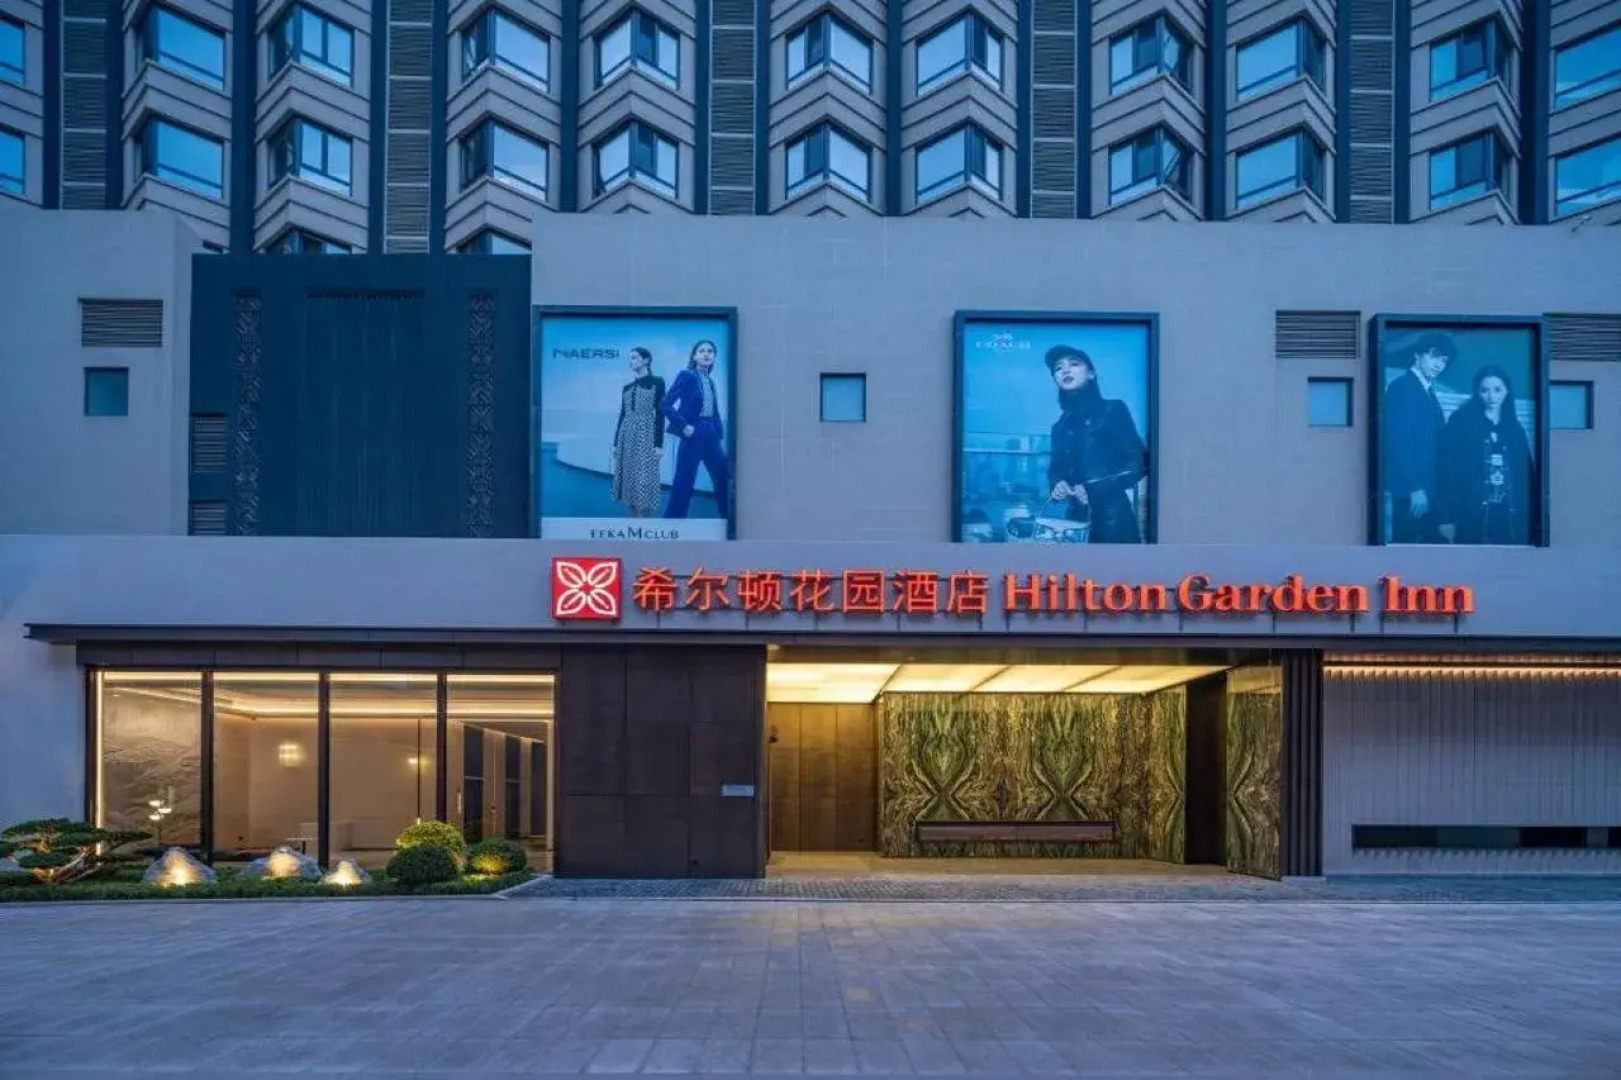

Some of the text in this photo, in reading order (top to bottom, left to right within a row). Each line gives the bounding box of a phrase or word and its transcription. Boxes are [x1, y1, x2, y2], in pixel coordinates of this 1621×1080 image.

[633, 567, 988, 612] 希尔顿花园酒店
[1004, 573, 1474, 613] Hilton Garden Inn
